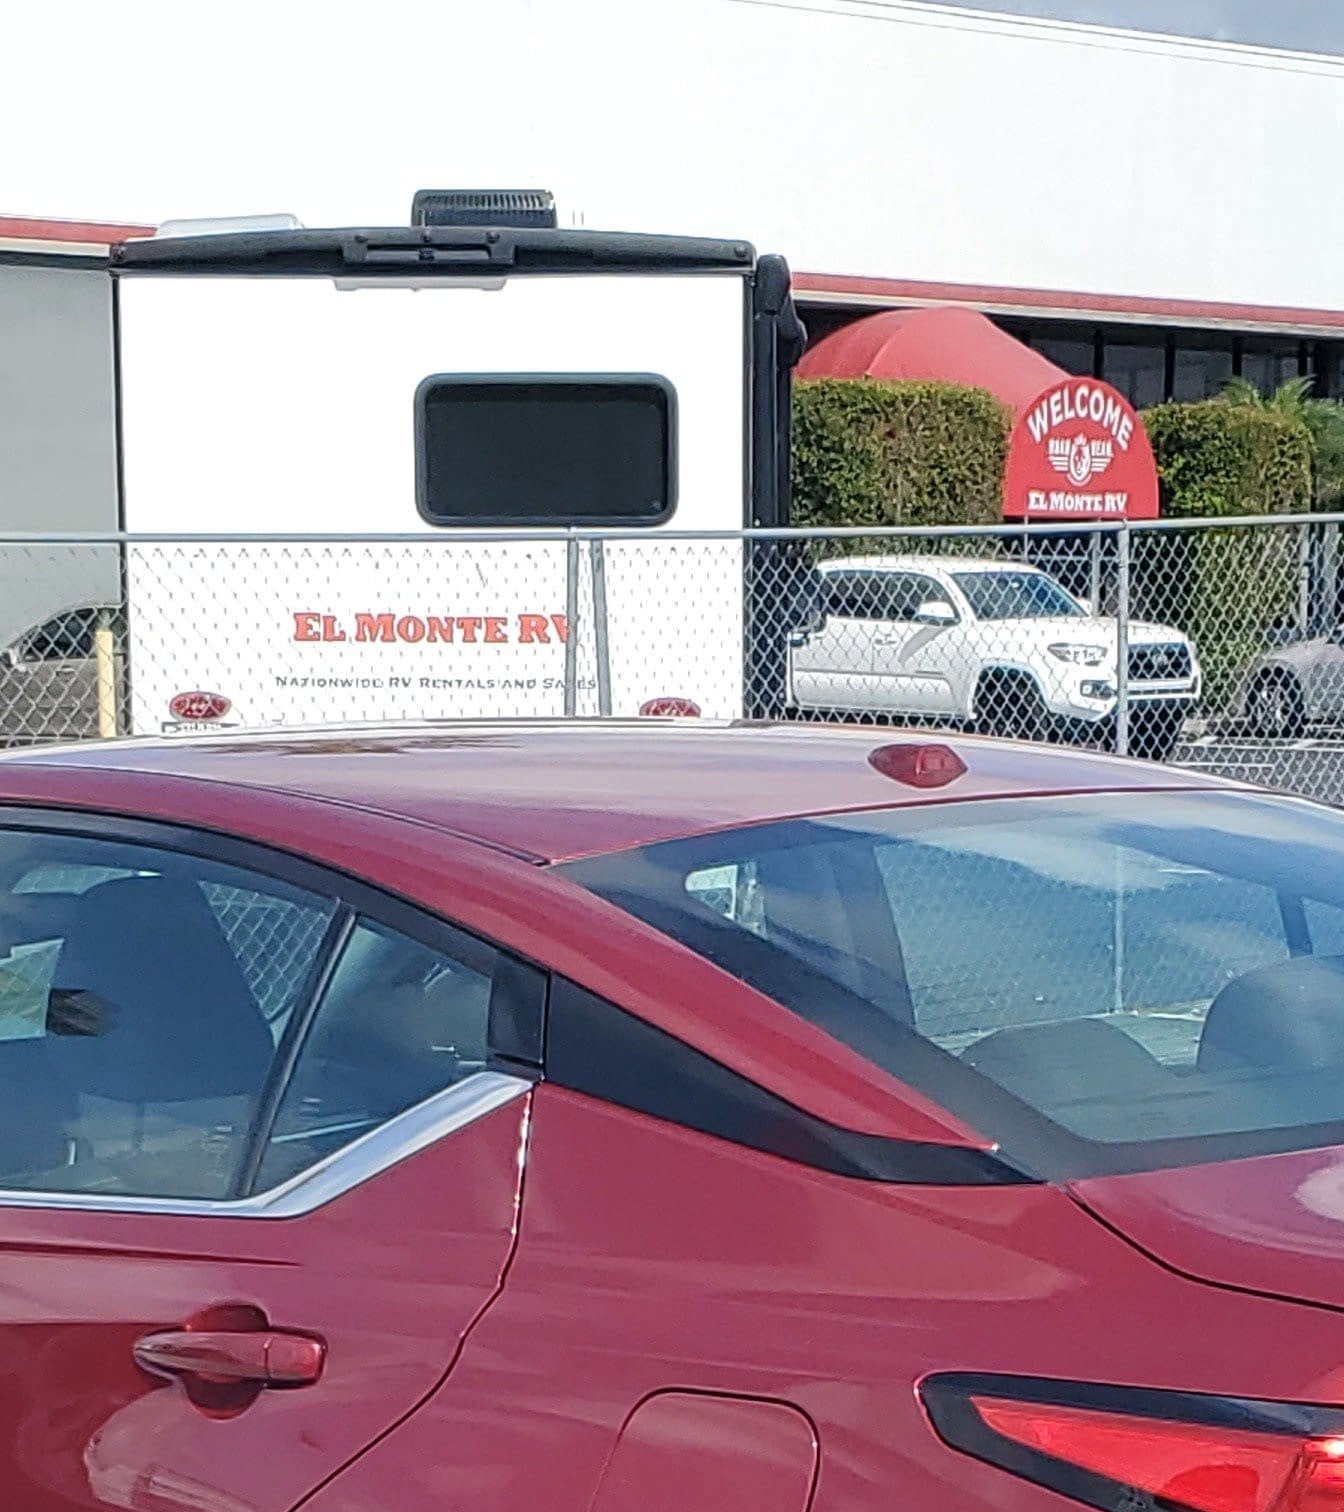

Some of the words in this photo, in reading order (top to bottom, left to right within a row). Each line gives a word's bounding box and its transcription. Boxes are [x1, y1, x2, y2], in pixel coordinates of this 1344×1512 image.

[1026, 384, 1135, 451] WELCOME
[1028, 490, 1047, 510] EL
[1049, 491, 1103, 512] MONTE
[1104, 491, 1129, 512] RV
[293, 612, 346, 642] EL
[354, 613, 509, 643] MONTE
[275, 675, 384, 689] NATIONWIDE
[388, 676, 412, 689] RV
[419, 677, 495, 689] RENTALS
[501, 678, 537, 690] AND
[542, 677, 597, 691] SAES
